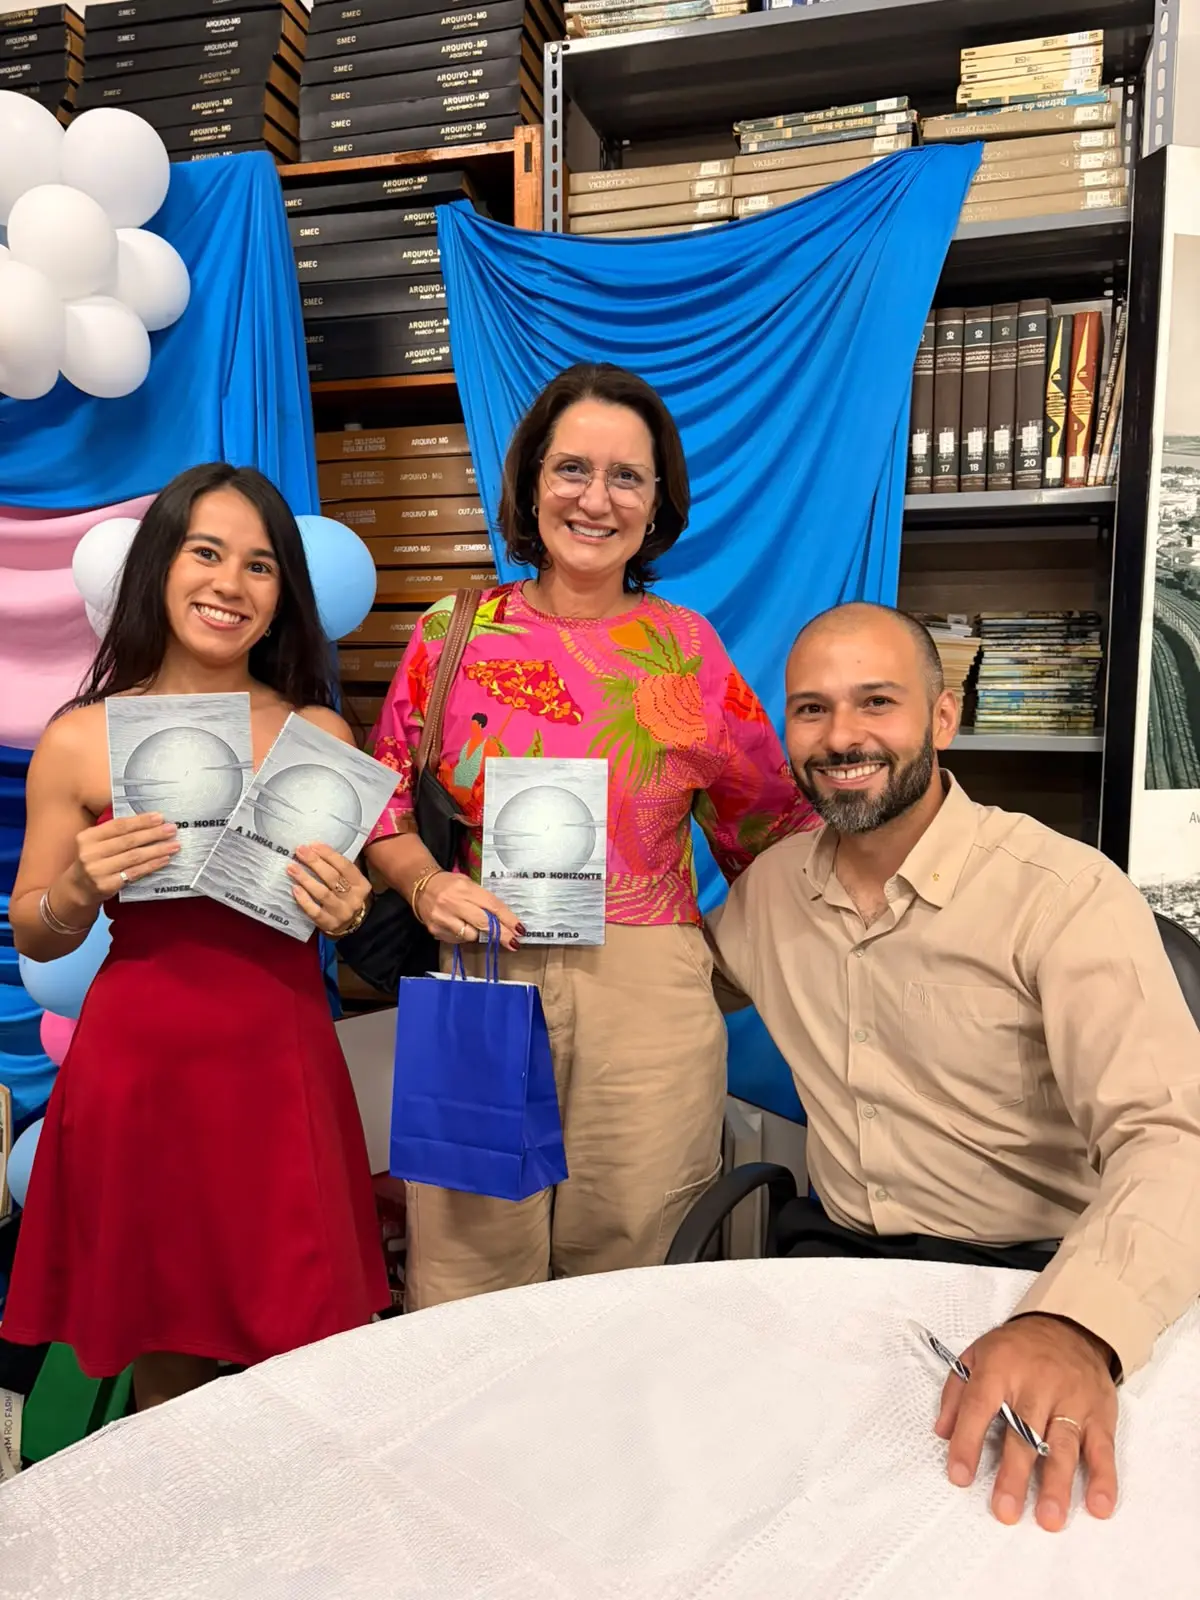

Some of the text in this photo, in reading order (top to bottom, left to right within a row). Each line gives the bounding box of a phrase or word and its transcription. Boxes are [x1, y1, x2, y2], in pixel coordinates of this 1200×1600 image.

[341, 9, 362, 19] SMEC
[117, 34, 136, 42] SMEC
[336, 35, 357, 46] SMEC
[333, 64, 353, 73] SMEC
[330, 91, 351, 101] SMEC
[1035, 97, 1066, 107] Retrato
[836, 105, 864, 116] Retrato
[331, 119, 351, 129] SMEC
[333, 144, 353, 153] SMEC
[300, 227, 320, 237] SMEC
[298, 260, 318, 269] SMEC
[303, 297, 324, 307] SMEC
[438, 436, 449, 444] MG
[969, 463, 979, 472] 18
[1023, 458, 1036, 468] 20
[941, 464, 951, 473] 17
[428, 509, 439, 517] MG
[454, 543, 487, 552] SETEMBRO
[235, 826, 290, 856] A LINHA DO
[490, 871, 497, 879] A
[532, 871, 546, 879] DO
[550, 871, 602, 880] HORIZONTE
[224, 891, 290, 927] VANDERLEI MELO
